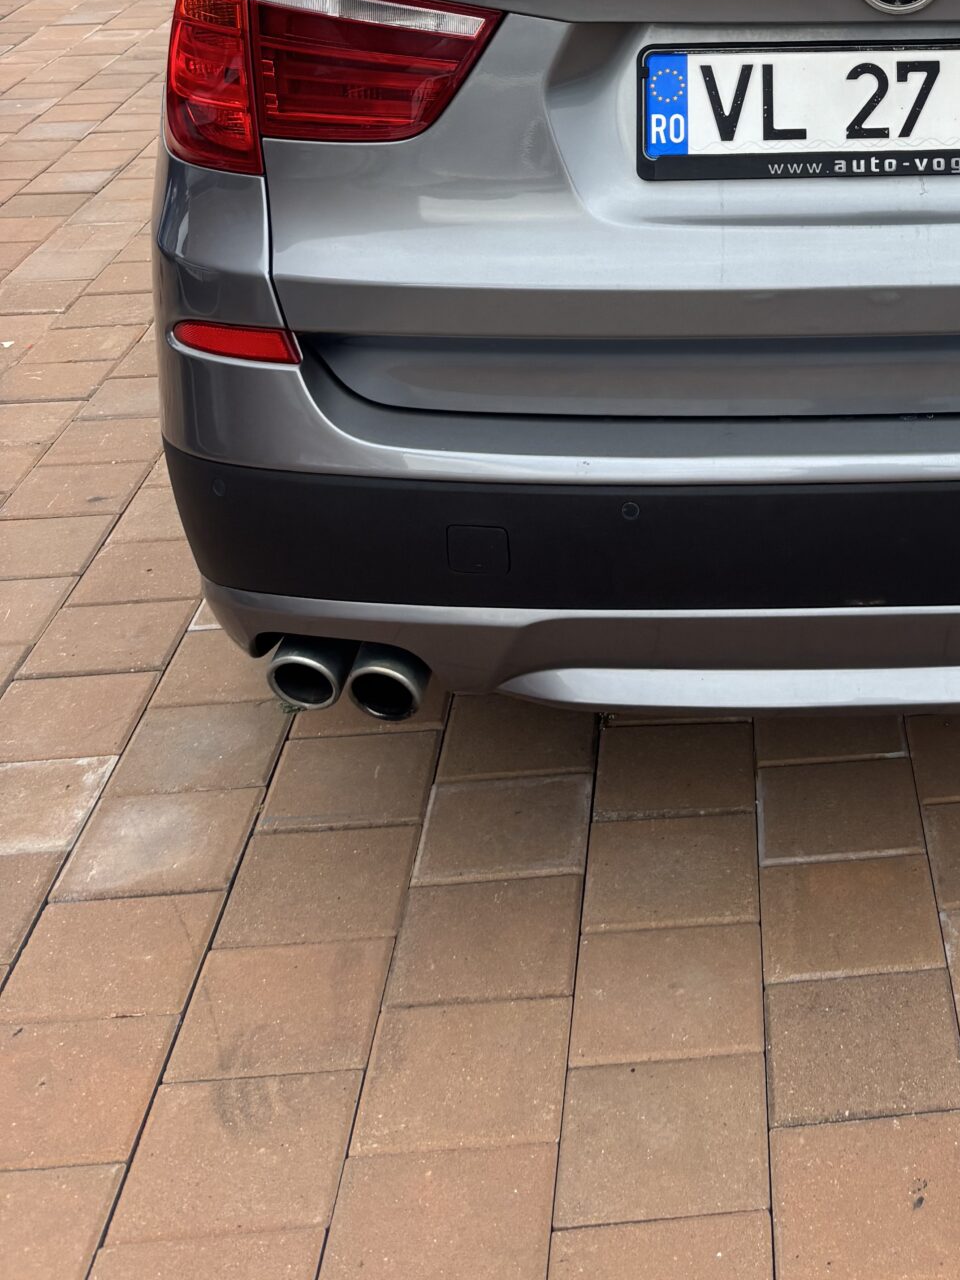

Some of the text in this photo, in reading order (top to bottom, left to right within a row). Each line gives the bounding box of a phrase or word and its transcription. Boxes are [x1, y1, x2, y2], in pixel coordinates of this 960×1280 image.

[651, 113, 685, 145] RO
[699, 63, 807, 142] VL
[845, 60, 941, 140] 27
